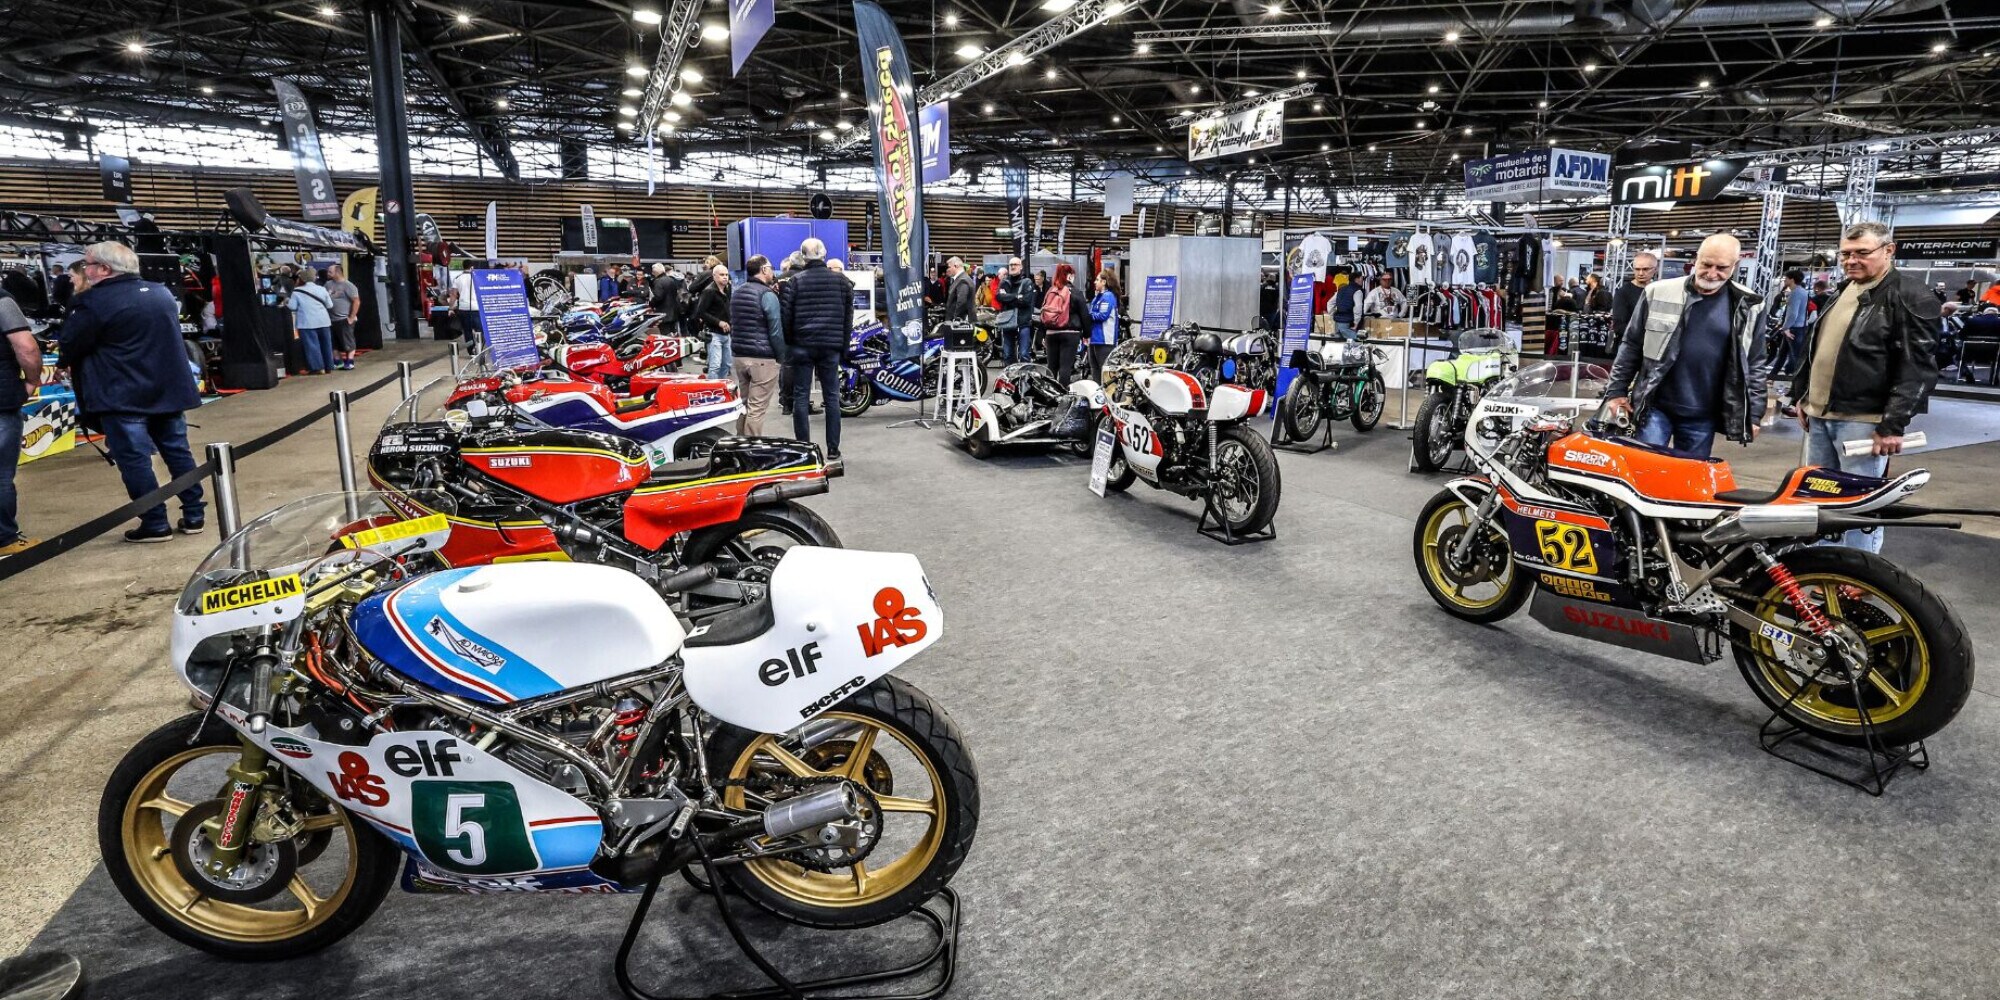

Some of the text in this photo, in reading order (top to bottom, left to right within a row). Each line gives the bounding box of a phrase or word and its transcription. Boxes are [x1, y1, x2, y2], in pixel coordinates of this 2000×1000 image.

[1219, 121, 1243, 139] MINI
[1495, 154, 1547, 169] mutuelle des
[1495, 163, 1547, 181] motards
[1554, 153, 1607, 183] AFDM
[1621, 165, 1711, 201] mitt
[1902, 241, 1992, 250] INTERPHONE
[650, 340, 678, 358] 23
[860, 361, 881, 370] YAMAHA
[1484, 405, 1518, 414] SUZUKI
[409, 445, 444, 453] SUZUKI
[489, 457, 531, 467] SUZUKI
[381, 488, 422, 518] SUZUK
[1516, 505, 1556, 519] HELMETS
[1540, 524, 1592, 568] 52
[206, 577, 296, 610] MICHELIN
[1542, 575, 1593, 591] OLIO
[857, 606, 928, 658] IAS
[1562, 605, 1670, 641] SUZUKI
[758, 641, 822, 687] elf
[384, 739, 461, 777] elf
[327, 773, 390, 807] IAS
[446, 794, 487, 867] 5
